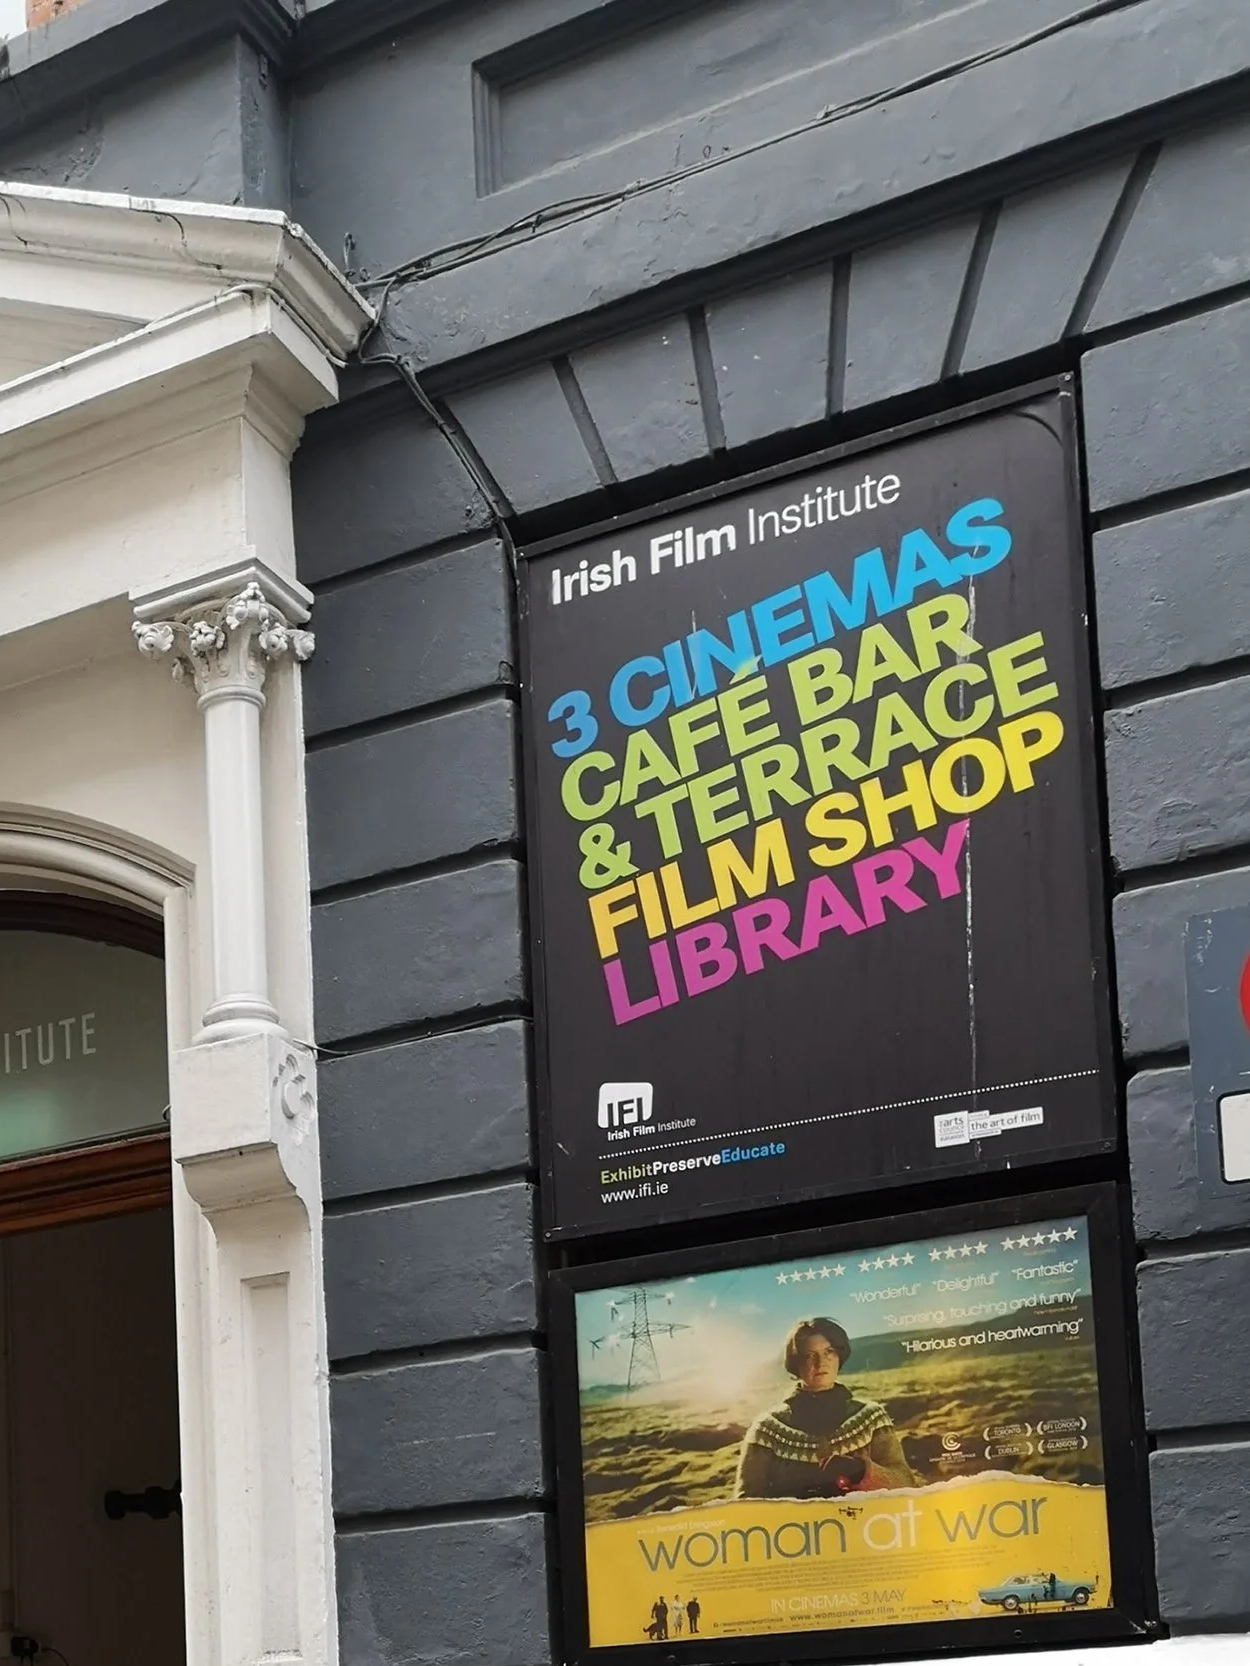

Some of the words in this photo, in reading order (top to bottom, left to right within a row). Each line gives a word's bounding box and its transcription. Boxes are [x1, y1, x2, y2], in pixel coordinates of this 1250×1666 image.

[551, 549, 637, 605] Irish
[650, 523, 736, 575] Film
[748, 474, 902, 545] Institute
[547, 689, 599, 759] 3
[608, 497, 1012, 728] CINEMAS
[560, 654, 781, 821] CAFÉ
[787, 592, 983, 726] BAR
[588, 818, 795, 960] FILM
[805, 710, 1065, 868] SHOP
[602, 818, 971, 1026] LIBRARY
[607, 1097, 644, 1126] IFI
[971, 1121, 988, 1131] the
[990, 1118, 1005, 1128] art
[1007, 1115, 1018, 1125] of
[1021, 1112, 1041, 1123] film
[607, 1128, 630, 1141] Irish
[633, 1124, 656, 1137] Film
[657, 1117, 697, 1132] Institute
[601, 1182, 670, 1203] www.ifi.ie
[950, 1299, 1008, 1318] touching
[1009, 1294, 1038, 1310] and
[959, 1331, 987, 1346] and
[638, 1517, 847, 1573] woman
[861, 1499, 922, 1553] at
[934, 1496, 1047, 1545] war
[771, 1597, 787, 1612] IN
[789, 1593, 858, 1611] CINEMAS
[861, 1591, 870, 1605] 3
[873, 1588, 908, 1603] MAY
